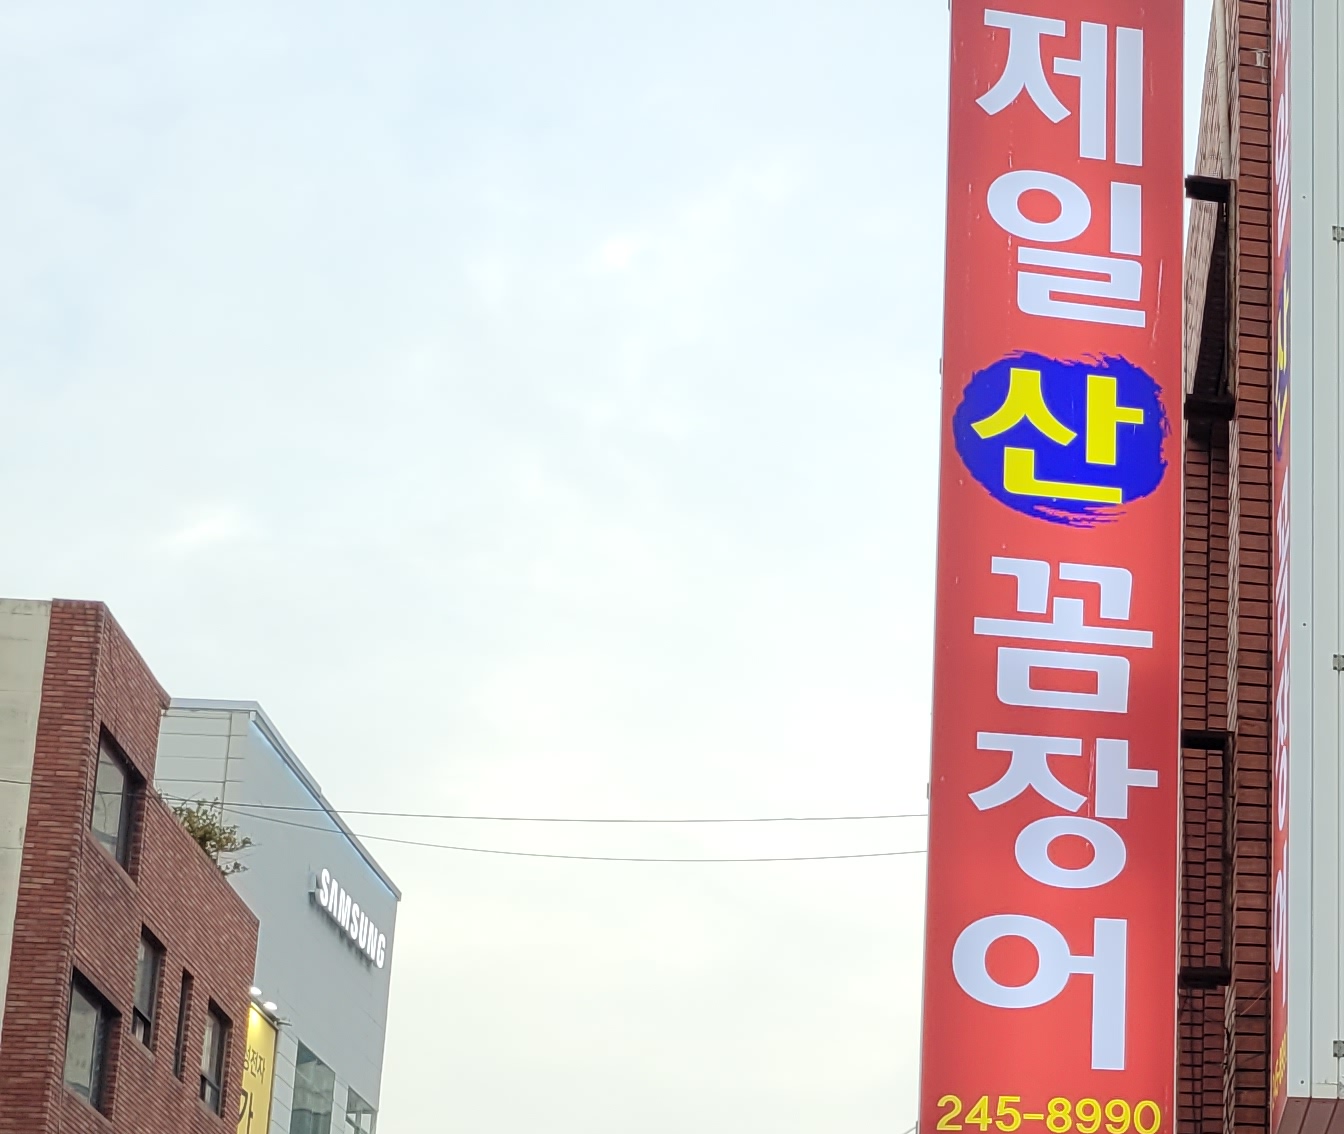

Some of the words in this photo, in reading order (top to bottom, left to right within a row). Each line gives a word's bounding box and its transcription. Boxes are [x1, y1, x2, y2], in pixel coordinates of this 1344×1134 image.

[975, 8, 1146, 328] 제일
[971, 368, 1144, 504] 산
[318, 867, 387, 969] SAMSUNG
[952, 556, 1158, 1071] 꼼장어
